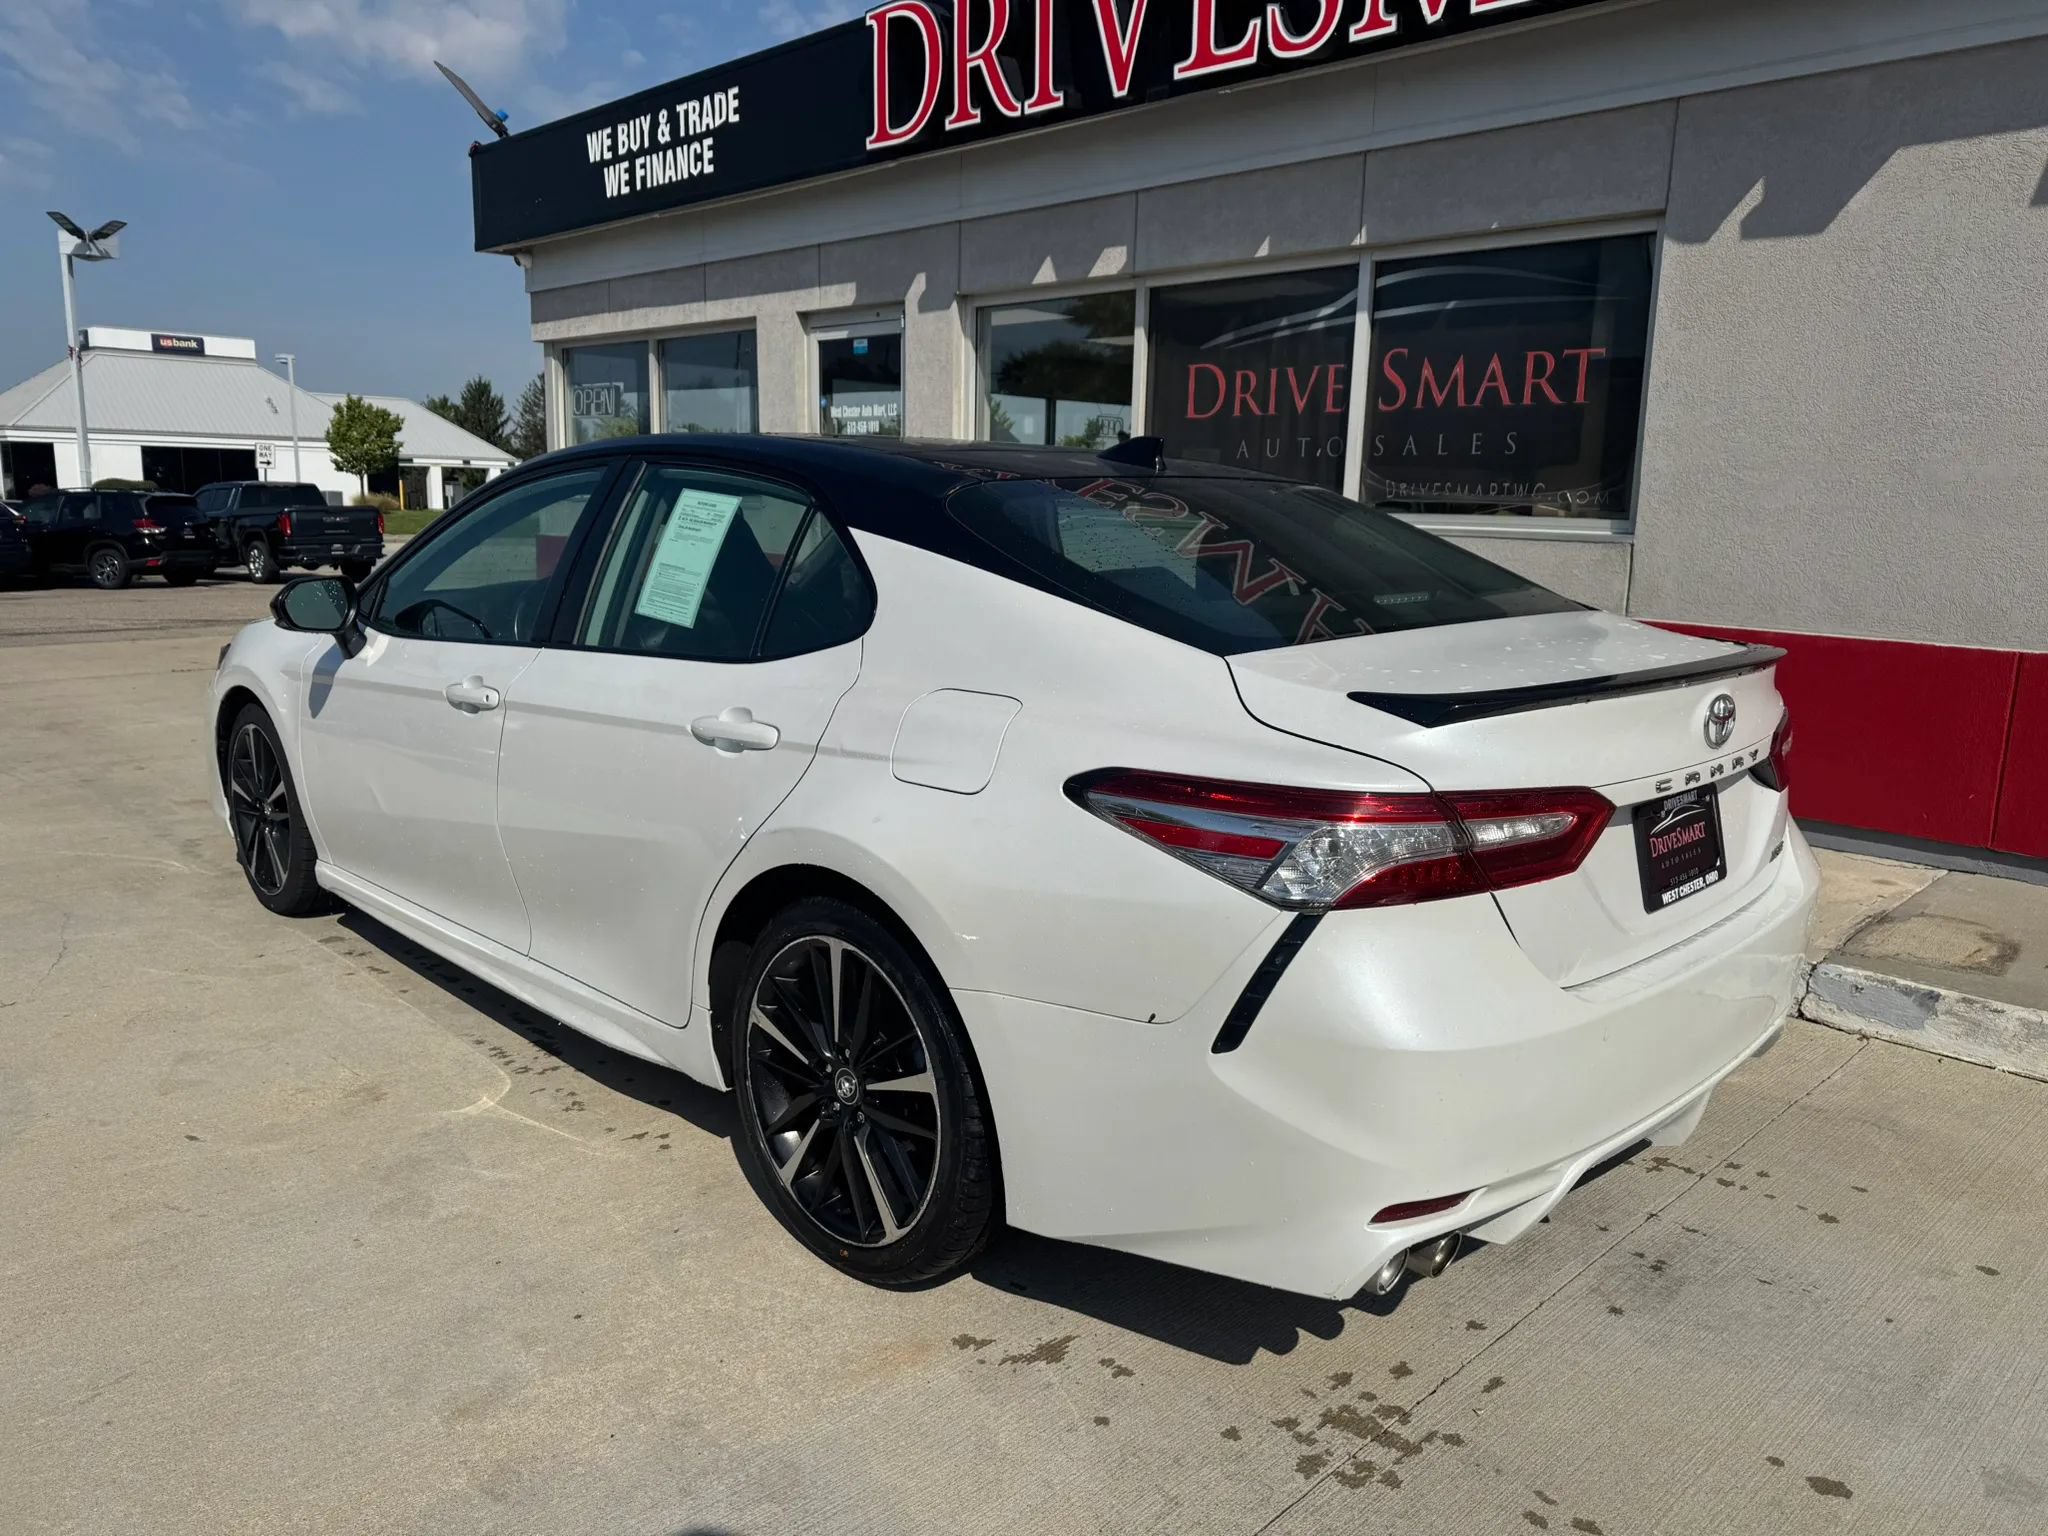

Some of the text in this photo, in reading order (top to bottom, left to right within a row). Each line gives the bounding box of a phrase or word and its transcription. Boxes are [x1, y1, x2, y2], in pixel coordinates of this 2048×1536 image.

[866, 0, 1535, 150] DRIV
[586, 85, 740, 164] WE BUY & TRADE
[603, 137, 715, 199] WE FINANCE
[573, 388, 615, 416] OPEN
[1373, 431, 1518, 457] SALES
[1655, 748, 1759, 793] CAMRY
[1661, 887, 1679, 905] WEST
[1705, 869, 1719, 885] OHIO
